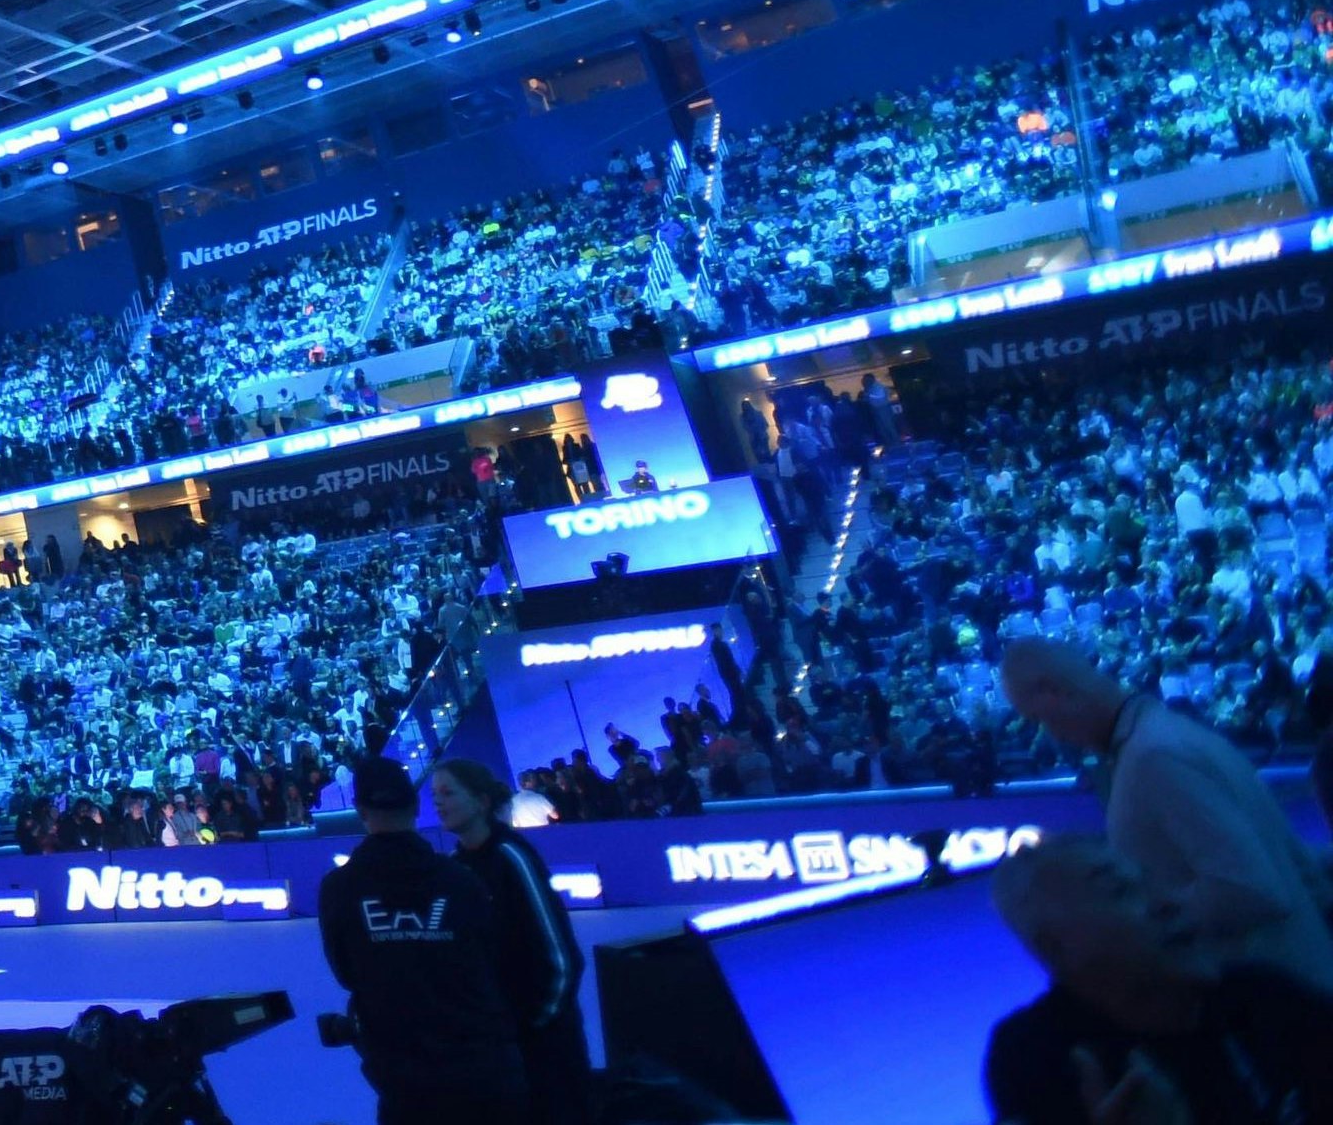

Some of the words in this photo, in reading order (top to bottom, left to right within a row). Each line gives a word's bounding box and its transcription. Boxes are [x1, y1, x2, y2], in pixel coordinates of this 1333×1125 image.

[181, 241, 251, 270] Nitto
[964, 335, 1090, 374] Nitto
[230, 484, 309, 511] Nitto
[545, 490, 710, 539] TORINO
[665, 839, 794, 883] INTESA
[66, 864, 225, 911] Nitto
